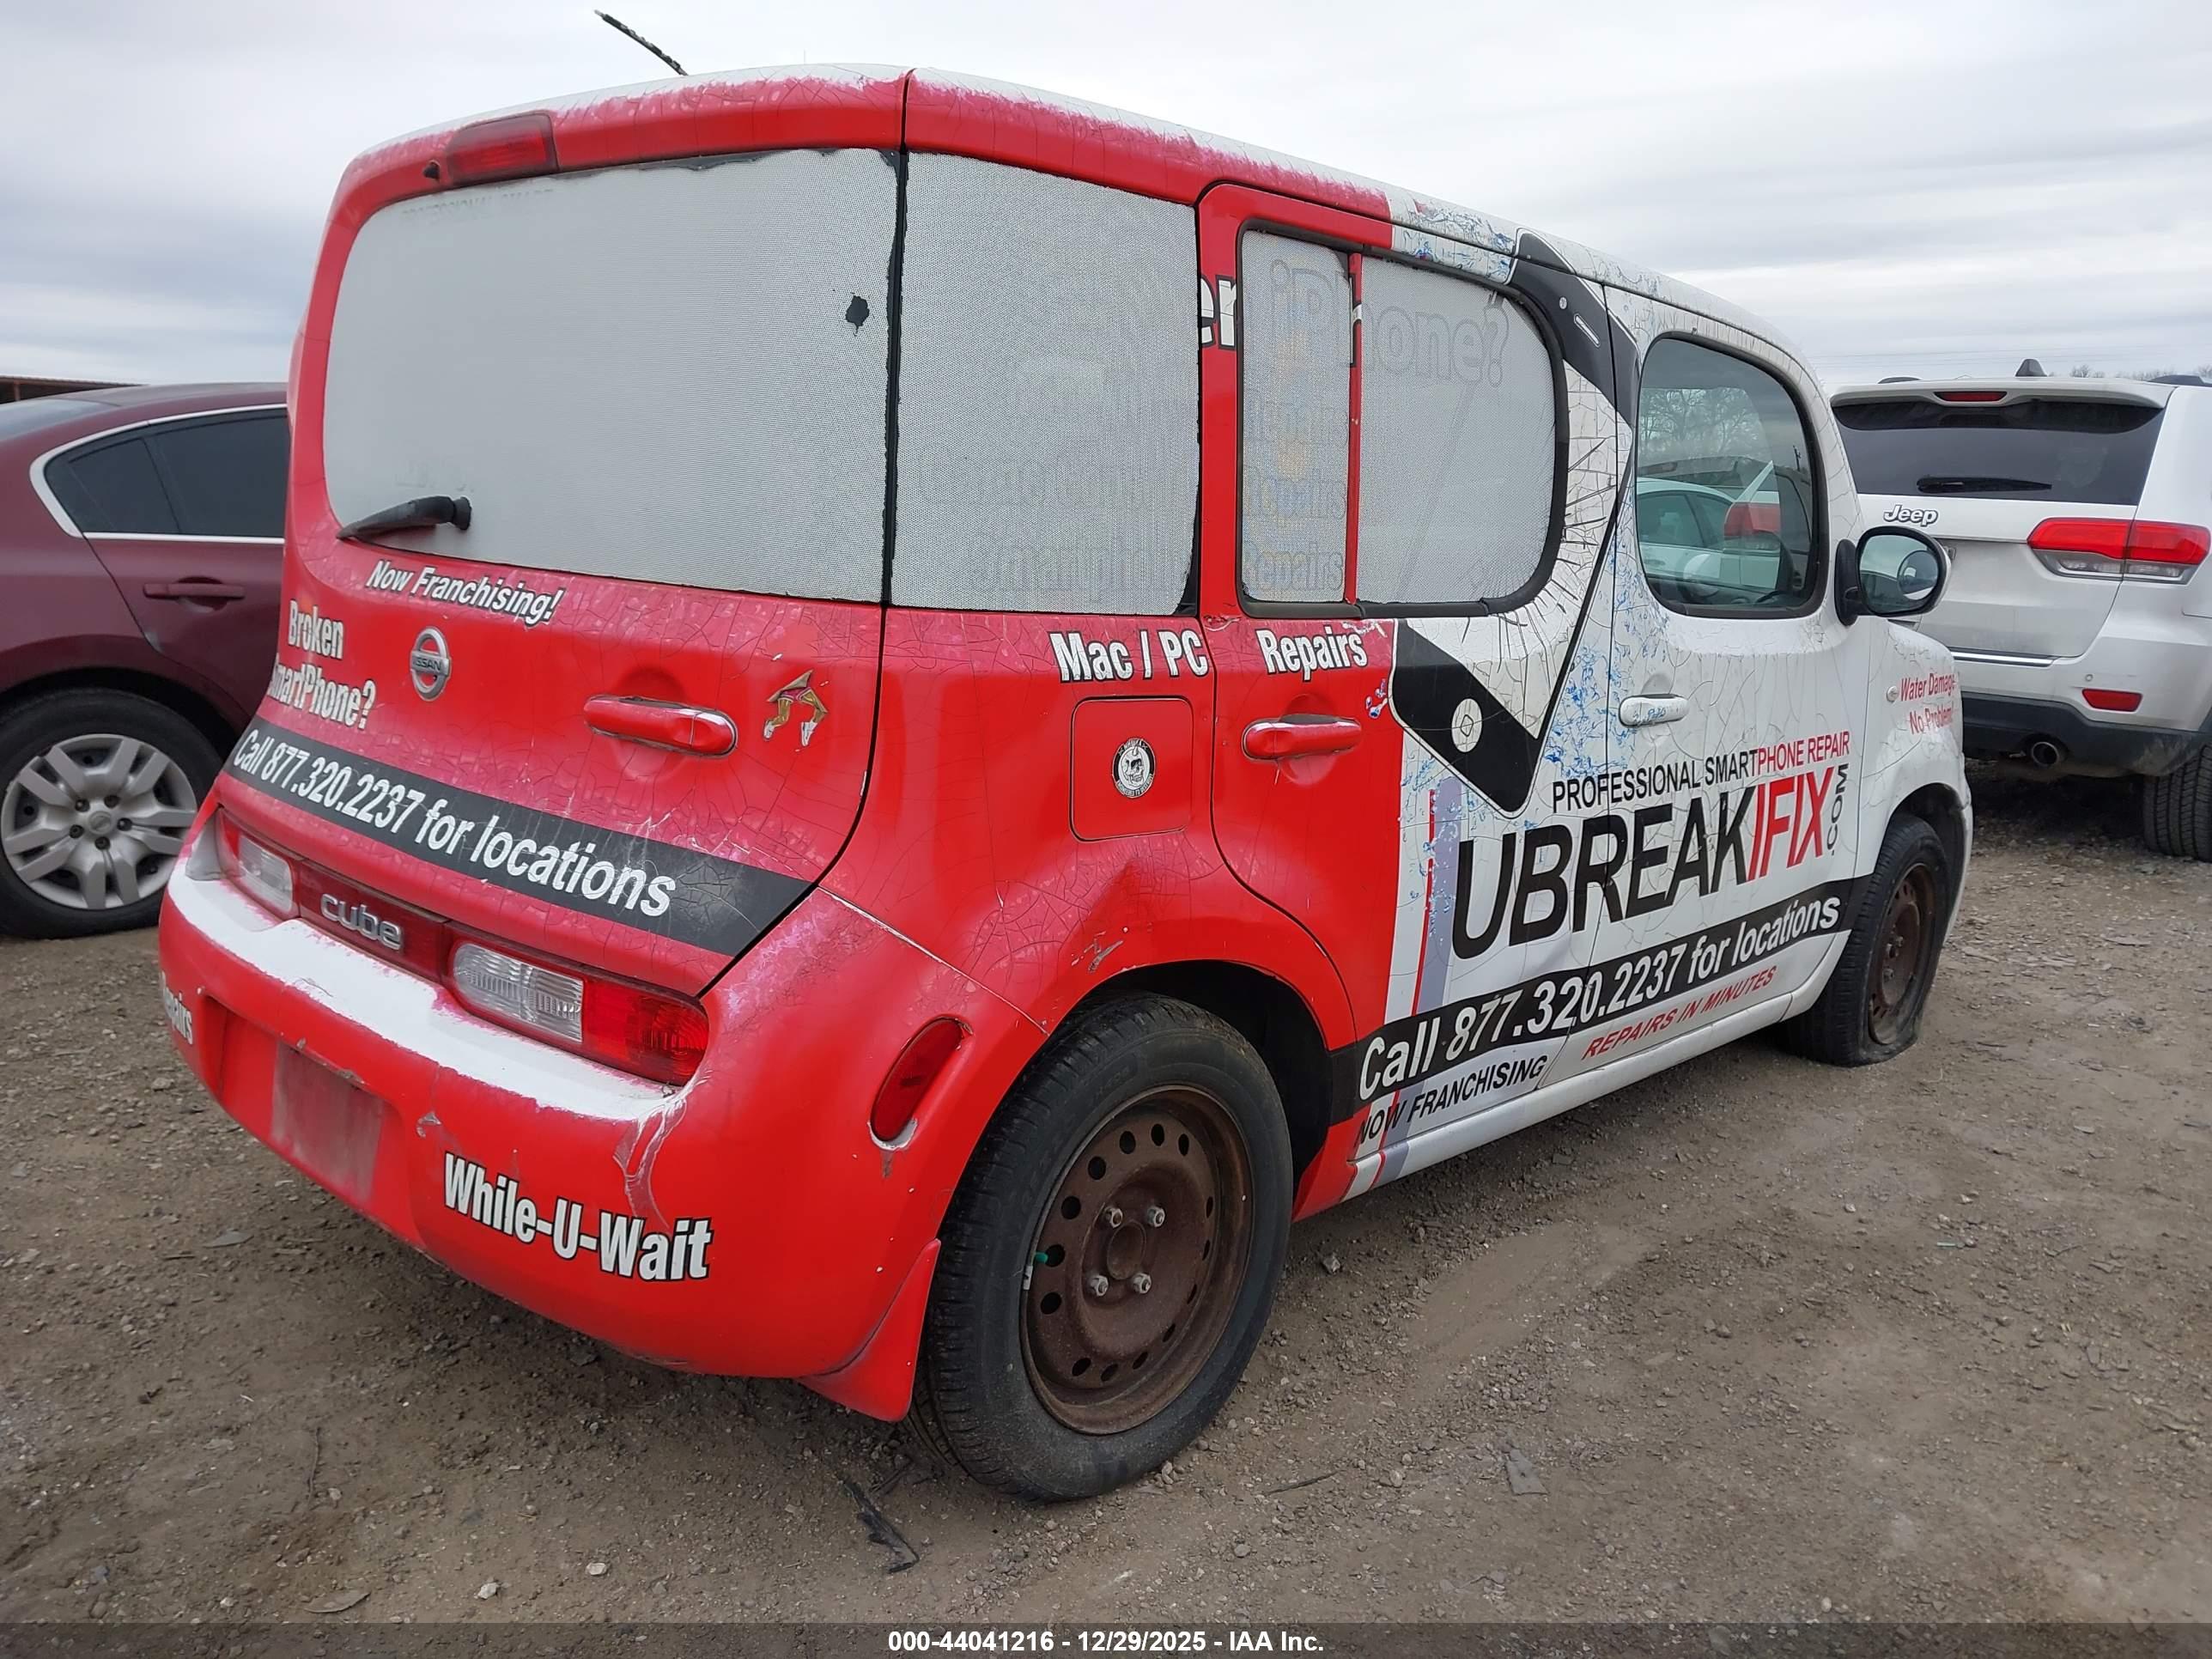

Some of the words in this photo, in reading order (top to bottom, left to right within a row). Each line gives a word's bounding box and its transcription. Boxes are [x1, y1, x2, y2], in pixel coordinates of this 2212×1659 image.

[1883, 505, 1938, 526] Jeep
[288, 599, 344, 660] Broken
[366, 560, 406, 592] Now
[412, 568, 566, 629] Franchising!
[1049, 631, 1134, 683] Mac
[1139, 629, 1152, 680] /
[1158, 629, 1209, 678] PC
[1255, 626, 1368, 683] Repairs
[1900, 677, 1927, 702] Water
[1910, 710, 1923, 734] No
[1553, 761, 1700, 813] PROFESSIONAL
[1705, 739, 1804, 787] SMARTPHONE
[1808, 730, 1850, 764] REPAIR
[234, 729, 275, 775] Call
[260, 742, 426, 834] 877.320.2237
[415, 799, 475, 855] for
[470, 815, 676, 916] locations
[1451, 766, 1834, 959] UBREAKIFIX
[320, 893, 403, 951] cube
[1359, 1016, 1440, 1101] Call
[1445, 943, 1688, 1061] 877.320.2237
[1687, 935, 1730, 984] for
[1731, 896, 1841, 967] locations
[1582, 1008, 1677, 1060] REPAIRS
[1677, 999, 1704, 1024] IN
[1701, 965, 1778, 1013] MINUTES
[1353, 1100, 1407, 1148] NOW
[1407, 1055, 1548, 1123] FRANCHISING
[444, 1152, 713, 1281] While-U-Wait
